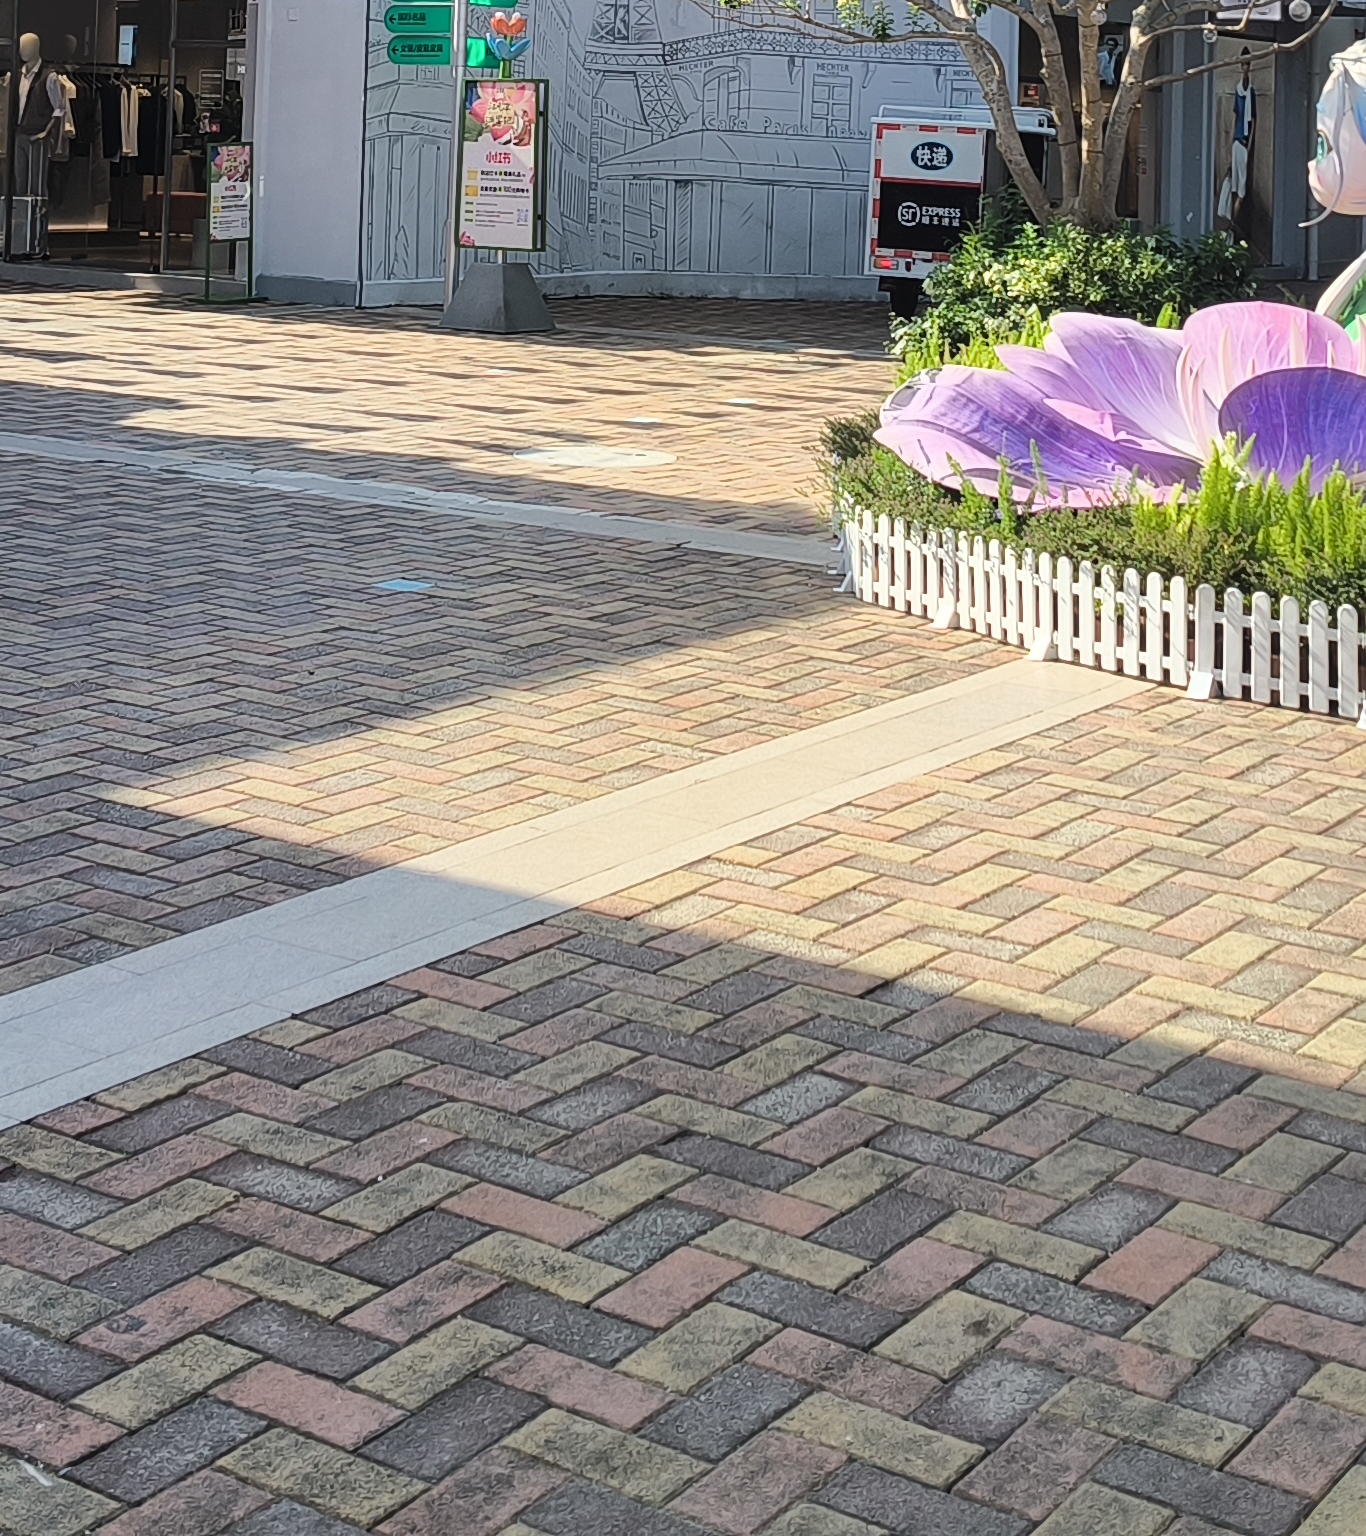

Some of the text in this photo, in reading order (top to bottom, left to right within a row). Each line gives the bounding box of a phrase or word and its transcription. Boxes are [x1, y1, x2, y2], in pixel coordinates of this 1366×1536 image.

[816, 62, 850, 72] HECHTER
[915, 145, 948, 167] 快递
[922, 206, 961, 218] EXPRESS
